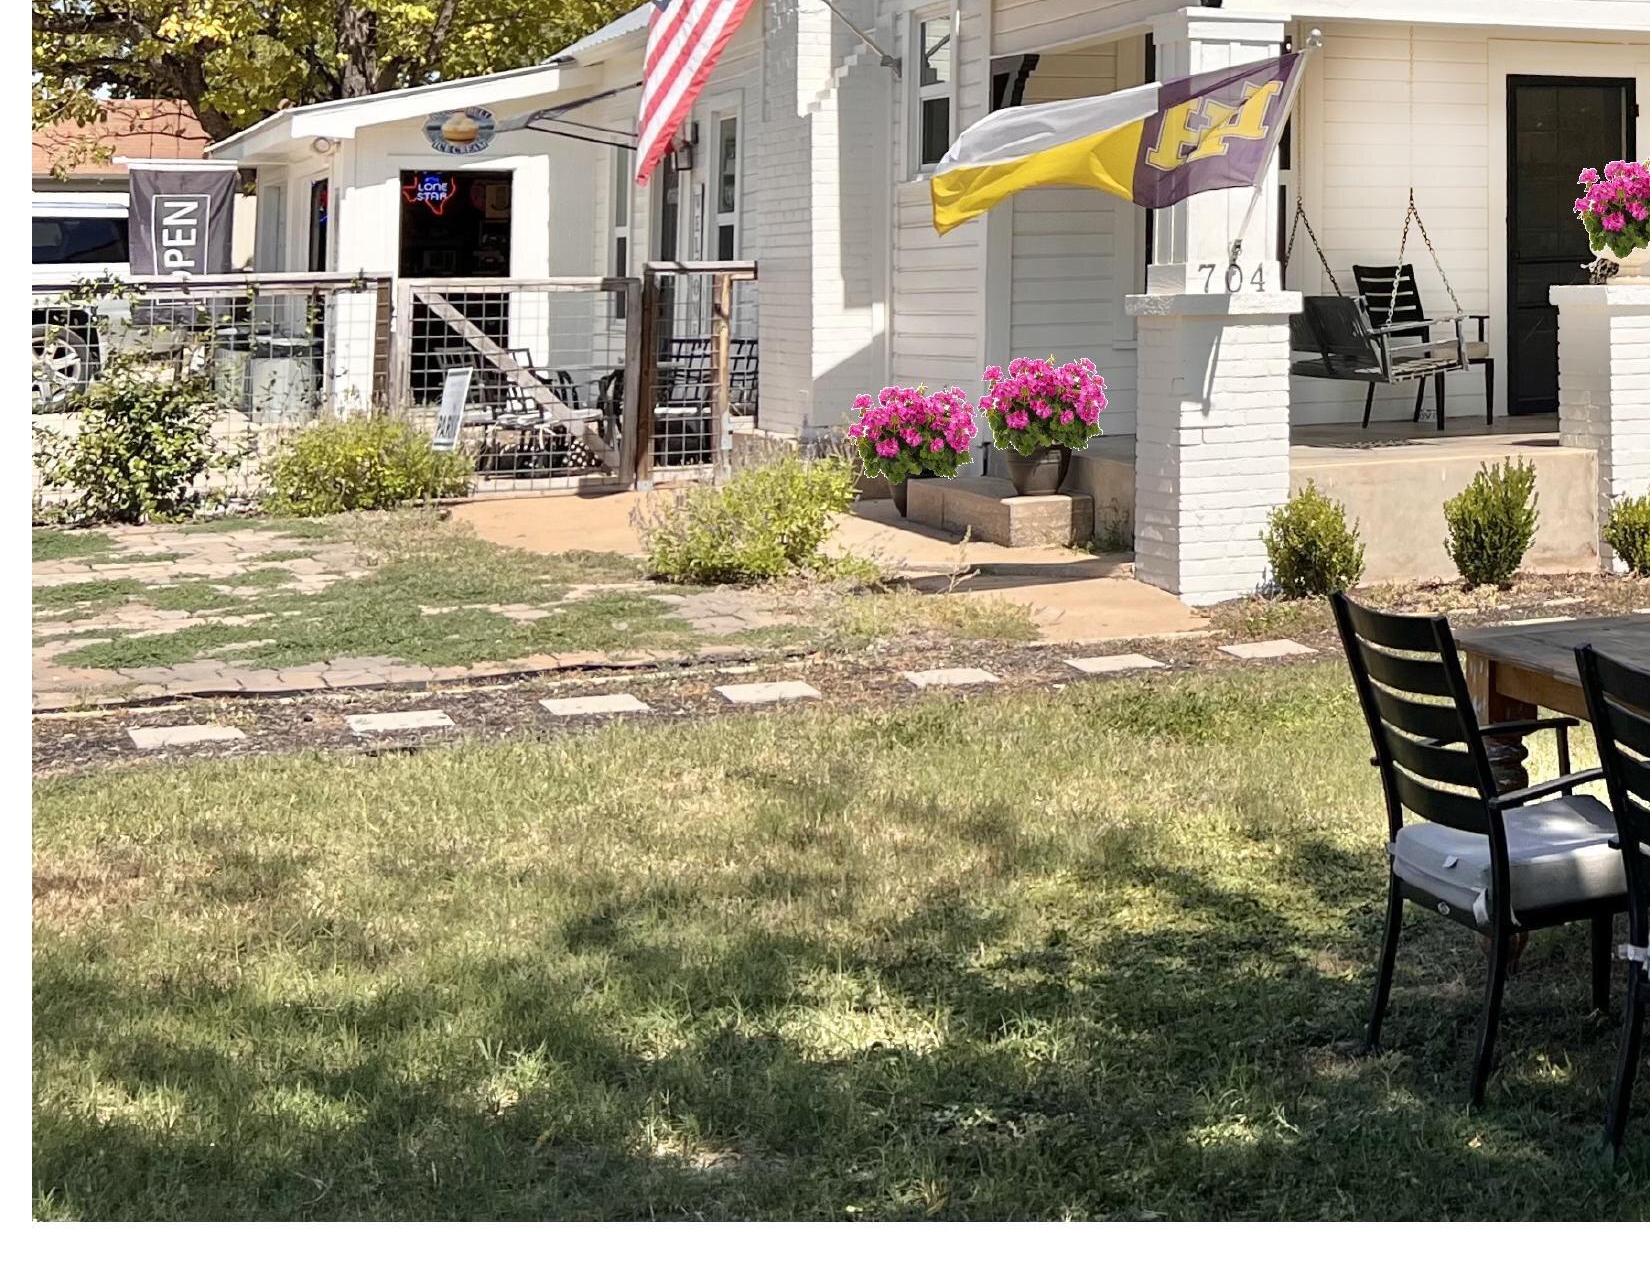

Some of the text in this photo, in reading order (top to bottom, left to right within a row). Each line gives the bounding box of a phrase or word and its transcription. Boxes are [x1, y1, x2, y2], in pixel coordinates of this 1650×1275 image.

[417, 192, 448, 201] STAR
[162, 201, 199, 276] PEN
[1198, 262, 1265, 293] 704
